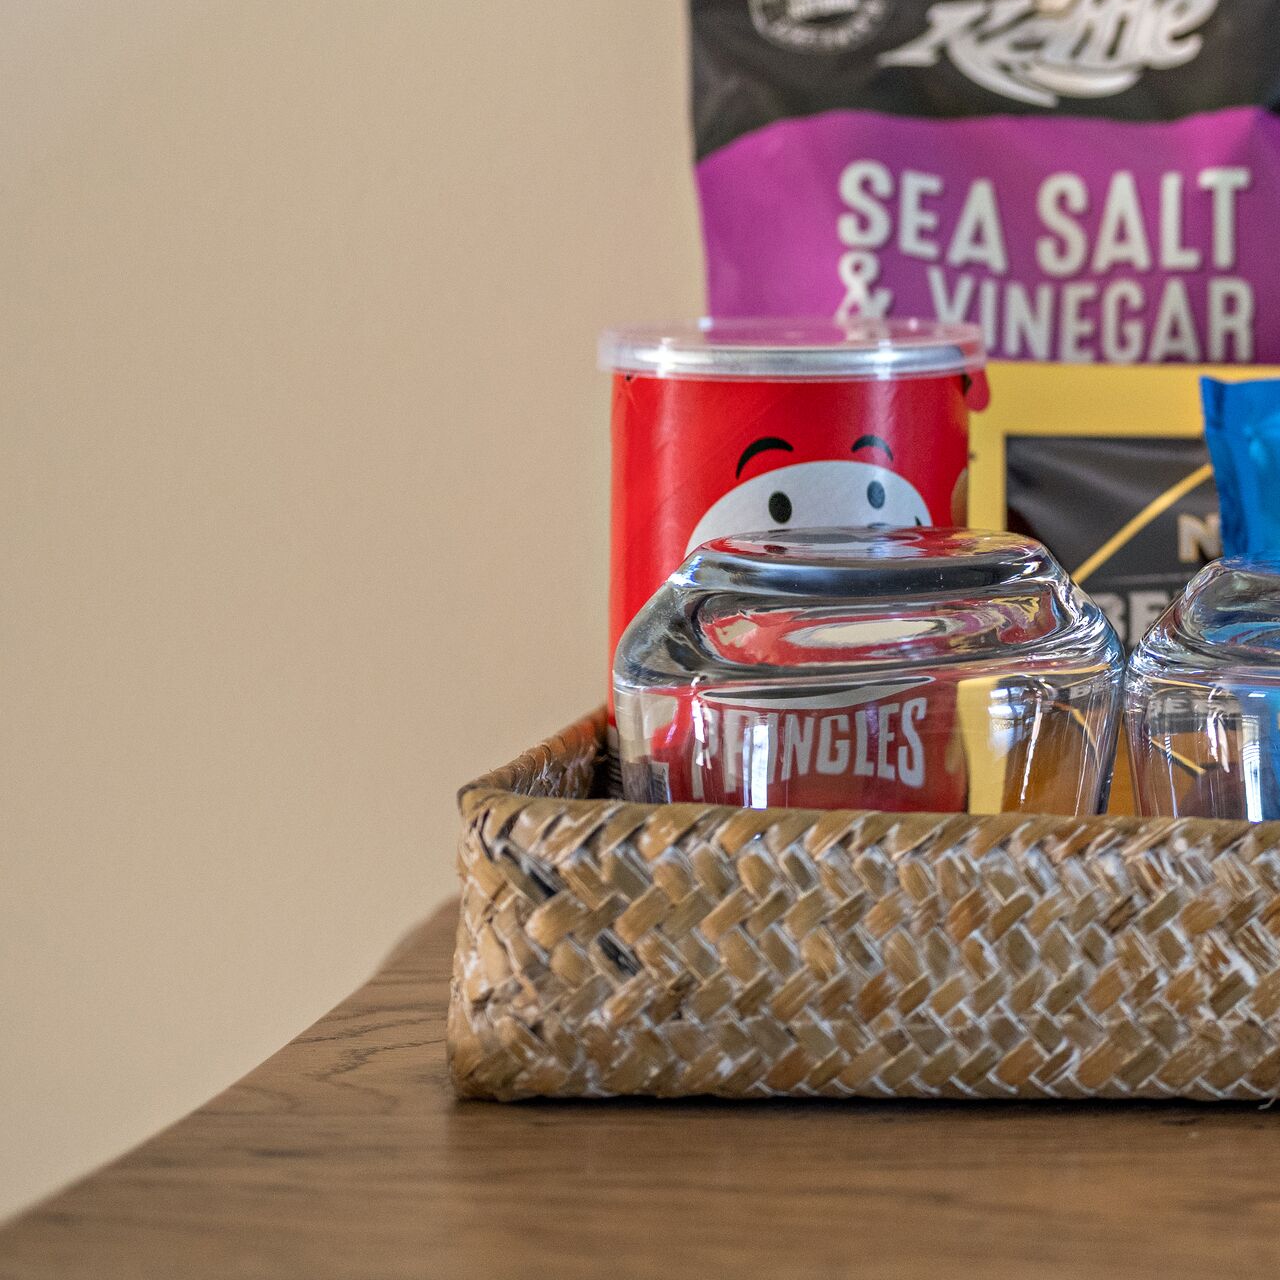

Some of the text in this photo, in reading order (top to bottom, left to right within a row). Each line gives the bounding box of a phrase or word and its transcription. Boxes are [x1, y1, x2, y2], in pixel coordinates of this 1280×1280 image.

[838, 160, 1250, 277] SEA SALT
[837, 250, 1256, 363] & VINEGAR
